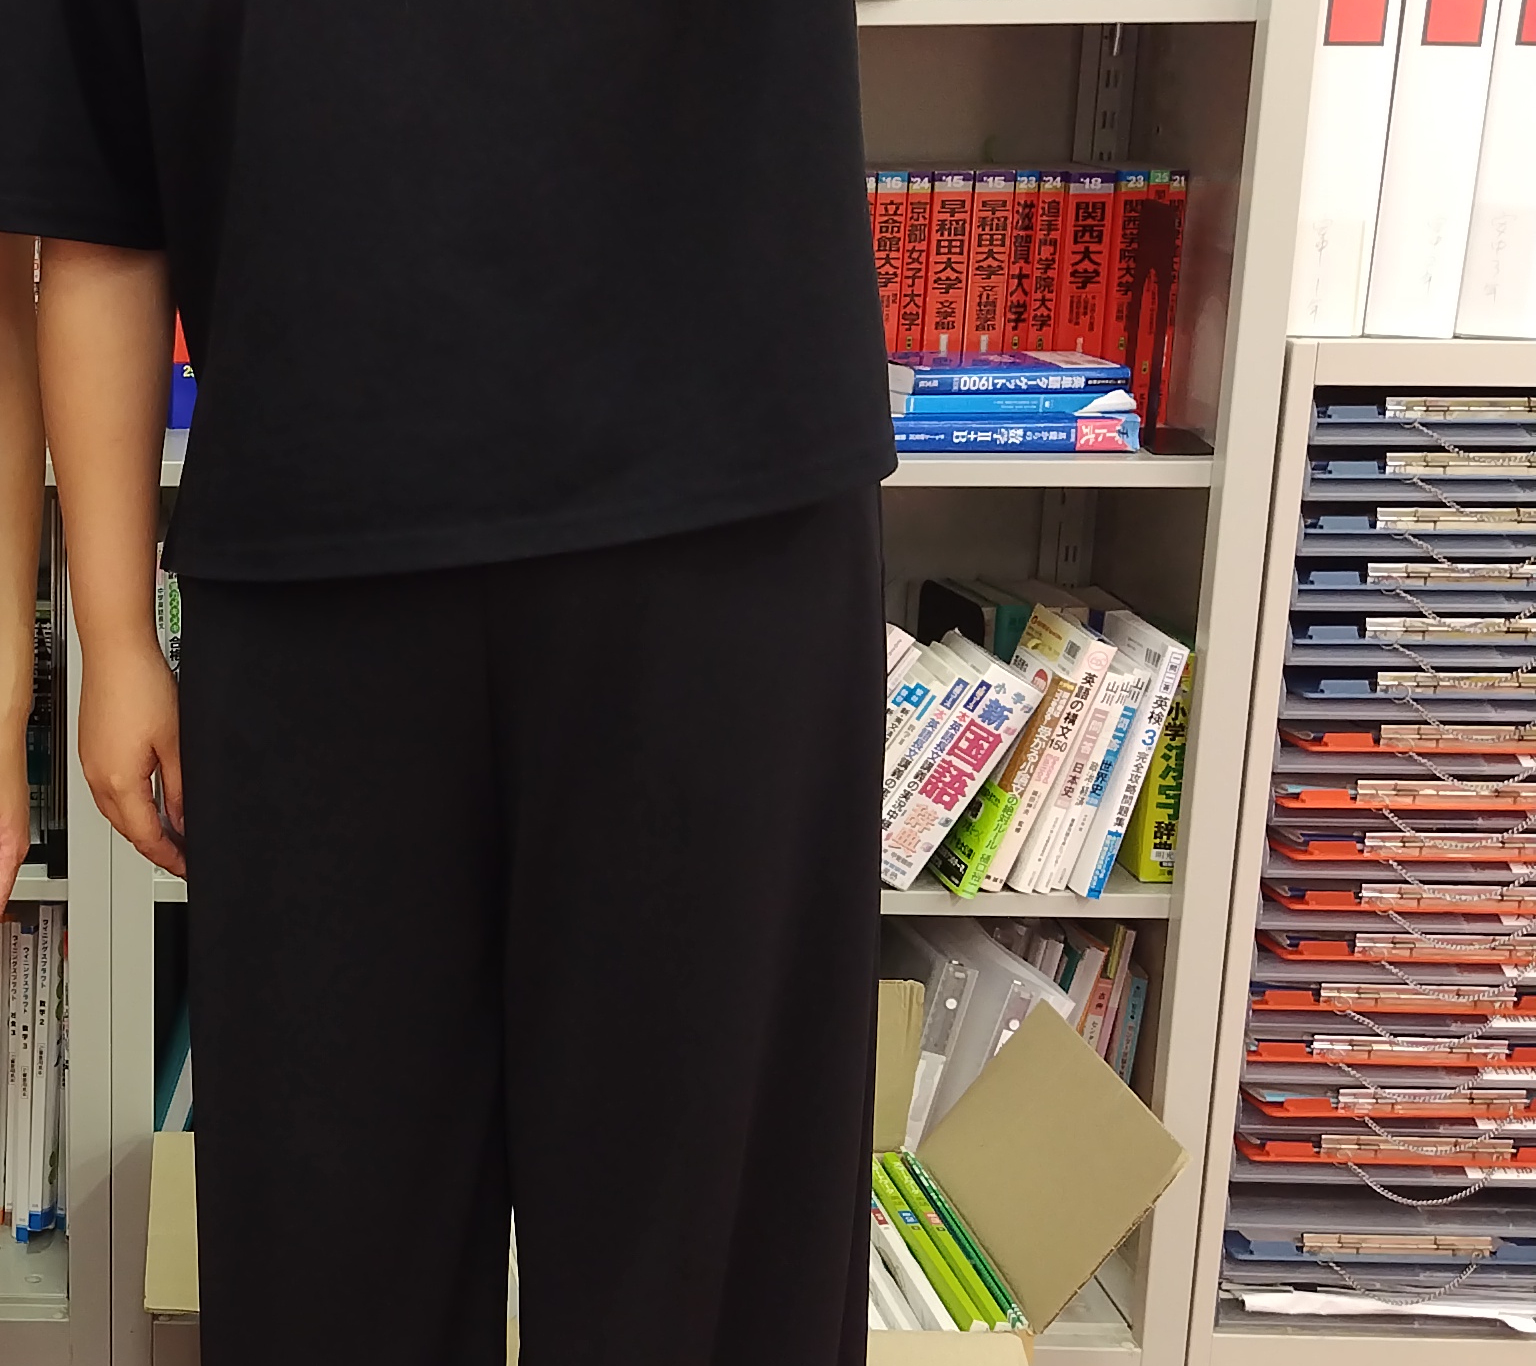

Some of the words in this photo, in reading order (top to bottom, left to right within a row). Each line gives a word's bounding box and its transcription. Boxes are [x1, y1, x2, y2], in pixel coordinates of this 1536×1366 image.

[881, 175, 902, 189] '16
[910, 176, 930, 190] '24
[942, 175, 964, 189] '15
[982, 176, 1006, 189] '15
[1017, 176, 1036, 189] '23
[1042, 175, 1062, 188] '24
[1080, 176, 1102, 191] '18
[875, 199, 904, 287] 立命館大学
[932, 199, 968, 295] 早稲田大学
[974, 199, 1008, 280] 早稲田大学
[1069, 201, 1106, 290] 関西大学
[901, 201, 930, 332] 京都女子大学
[1007, 198, 1036, 331] 滋賀大学
[1031, 199, 1061, 332] 追手門学院大学
[934, 299, 957, 331] 文学部
[960, 374, 1085, 392] 英単語ターゲット1900
[1100, 680, 1118, 706] 山川
[1115, 679, 1130, 706] 山川
[1129, 677, 1146, 703] 山川
[1048, 672, 1099, 753] 英語の構文150
[1060, 762, 1085, 799] 日本史
[1088, 759, 1114, 797] 世界史
[38, 1000, 47, 1026] 数学2
[21, 1025, 29, 1050] 数学3
